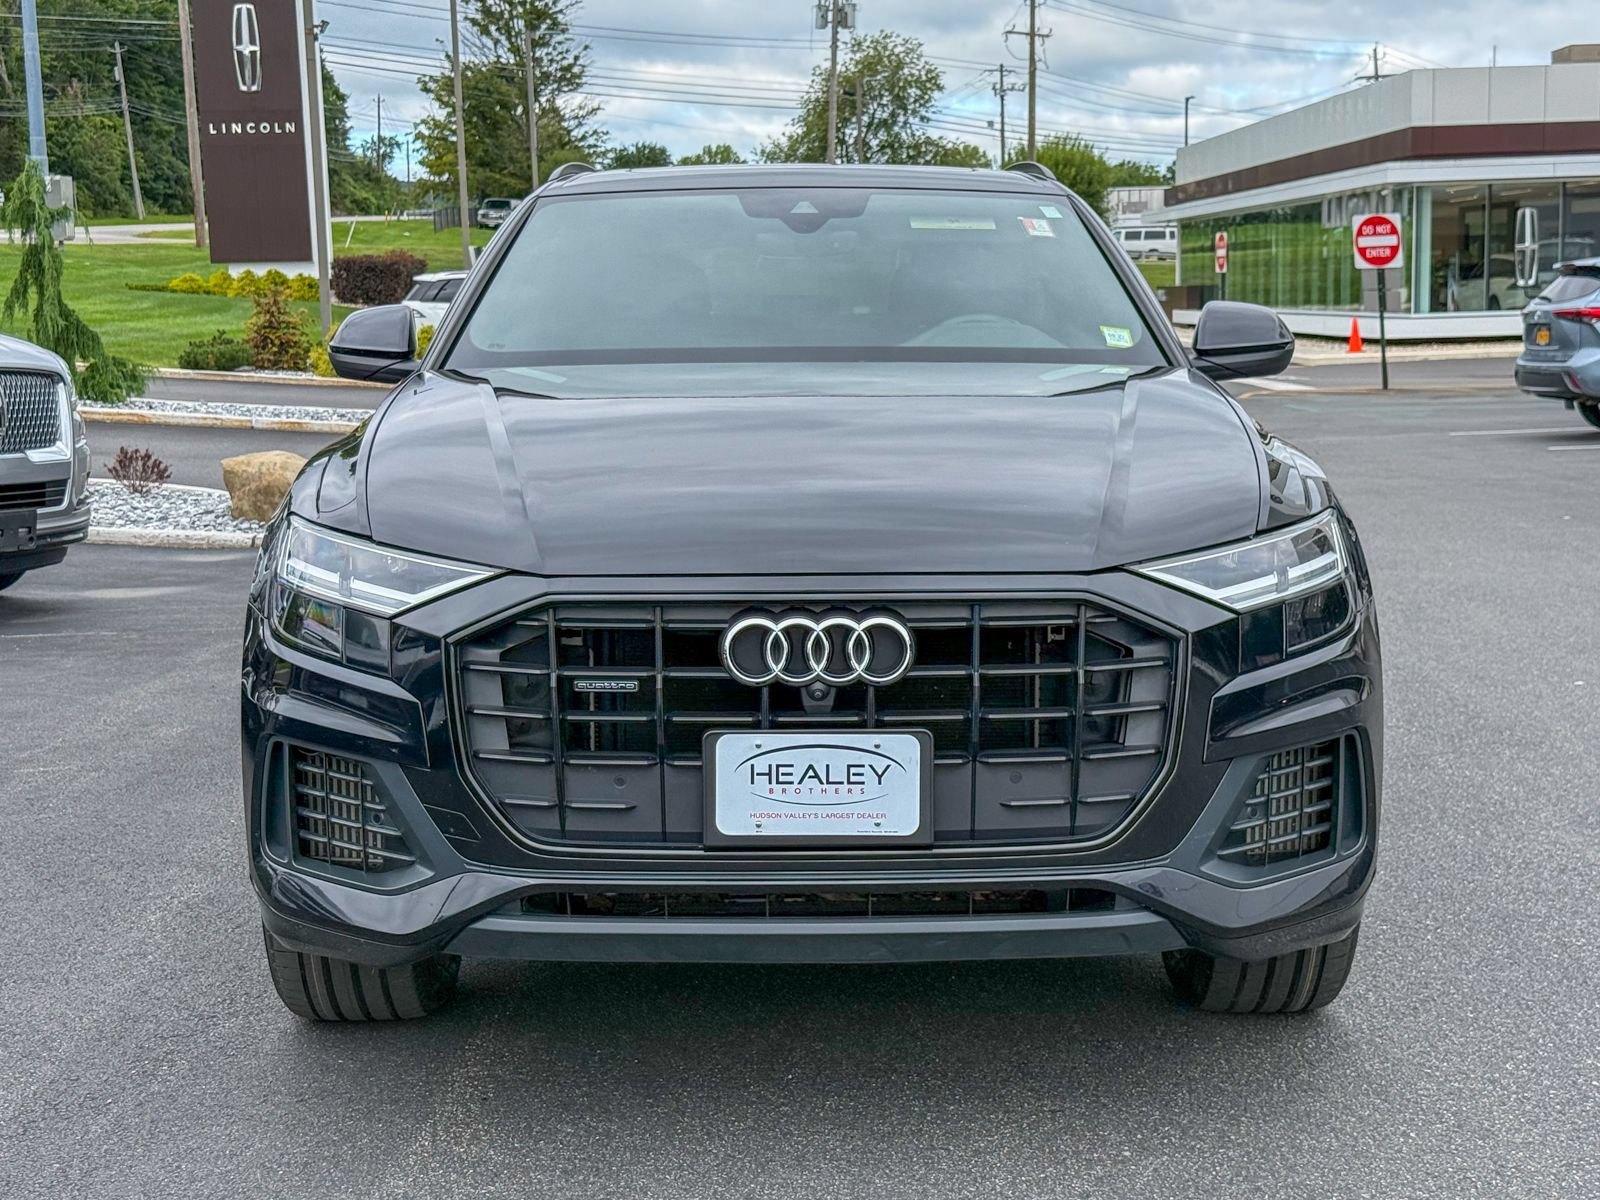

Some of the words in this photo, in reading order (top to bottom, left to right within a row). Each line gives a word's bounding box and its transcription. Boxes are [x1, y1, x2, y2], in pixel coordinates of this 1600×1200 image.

[208, 122, 296, 135] LINCOLN
[1361, 224, 1375, 236] DO
[1375, 223, 1392, 235] NOT
[1365, 247, 1392, 258] ENTER
[577, 682, 635, 690] quattro
[750, 763, 892, 785] HEALEY
[768, 787, 866, 795] BROTHERS
[856, 812, 887, 820] DEALER
